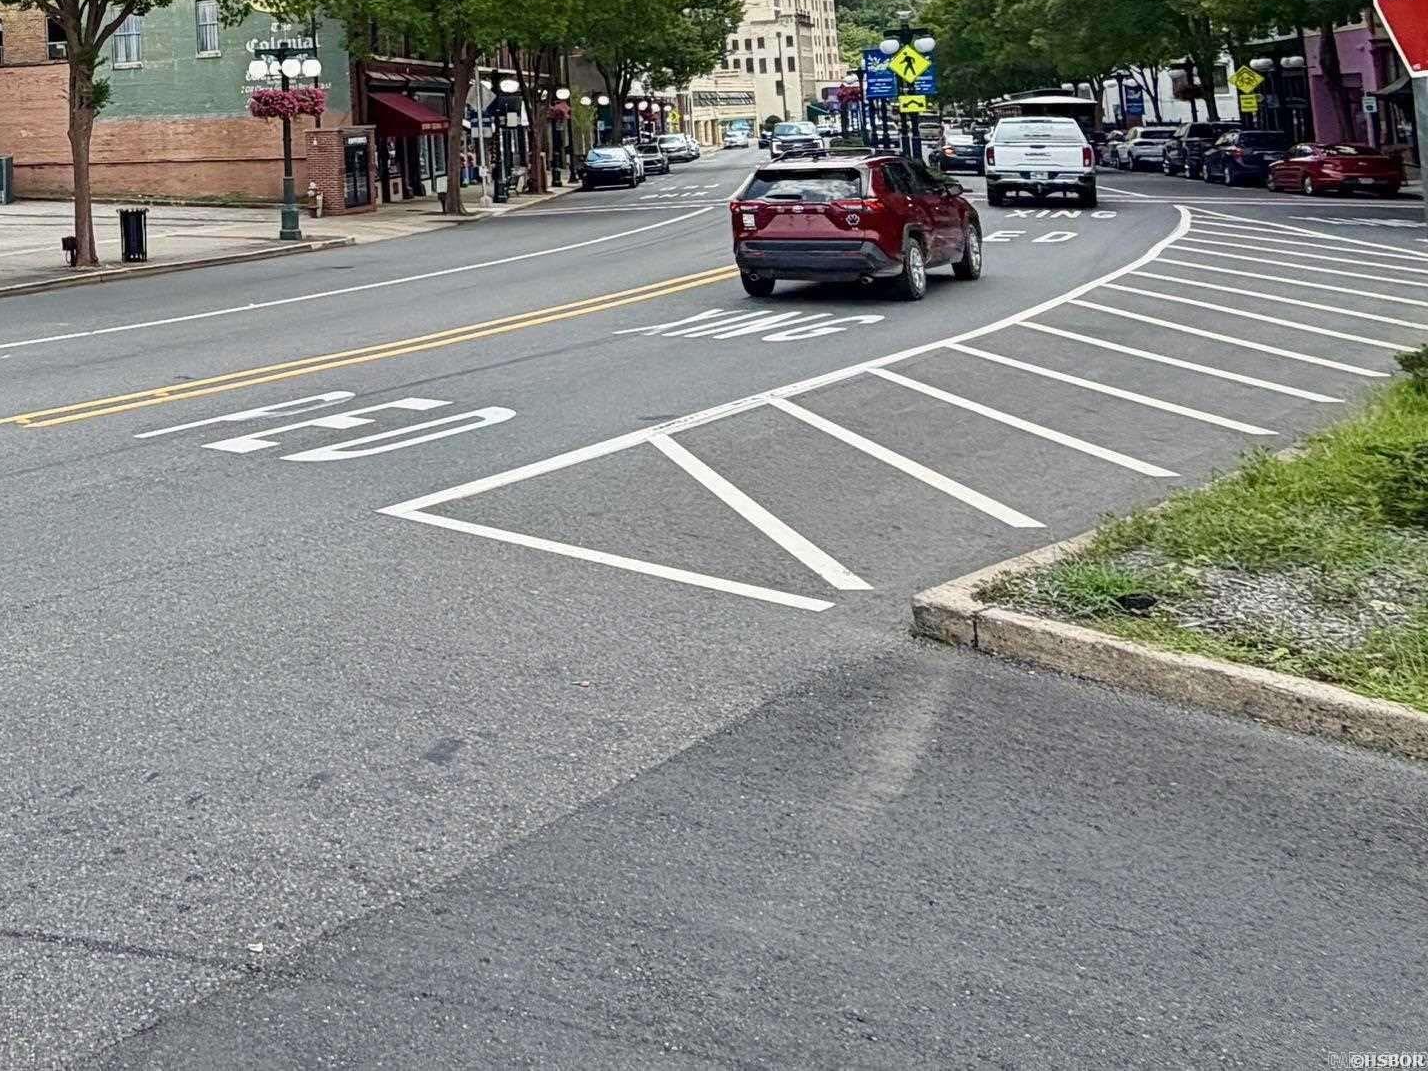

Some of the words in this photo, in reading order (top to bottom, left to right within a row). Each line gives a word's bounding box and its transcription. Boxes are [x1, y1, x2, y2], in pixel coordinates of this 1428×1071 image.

[1004, 209, 1118, 219] XING
[982, 230, 1079, 243] ED
[612, 308, 886, 342] XING
[133, 390, 517, 463] PED
